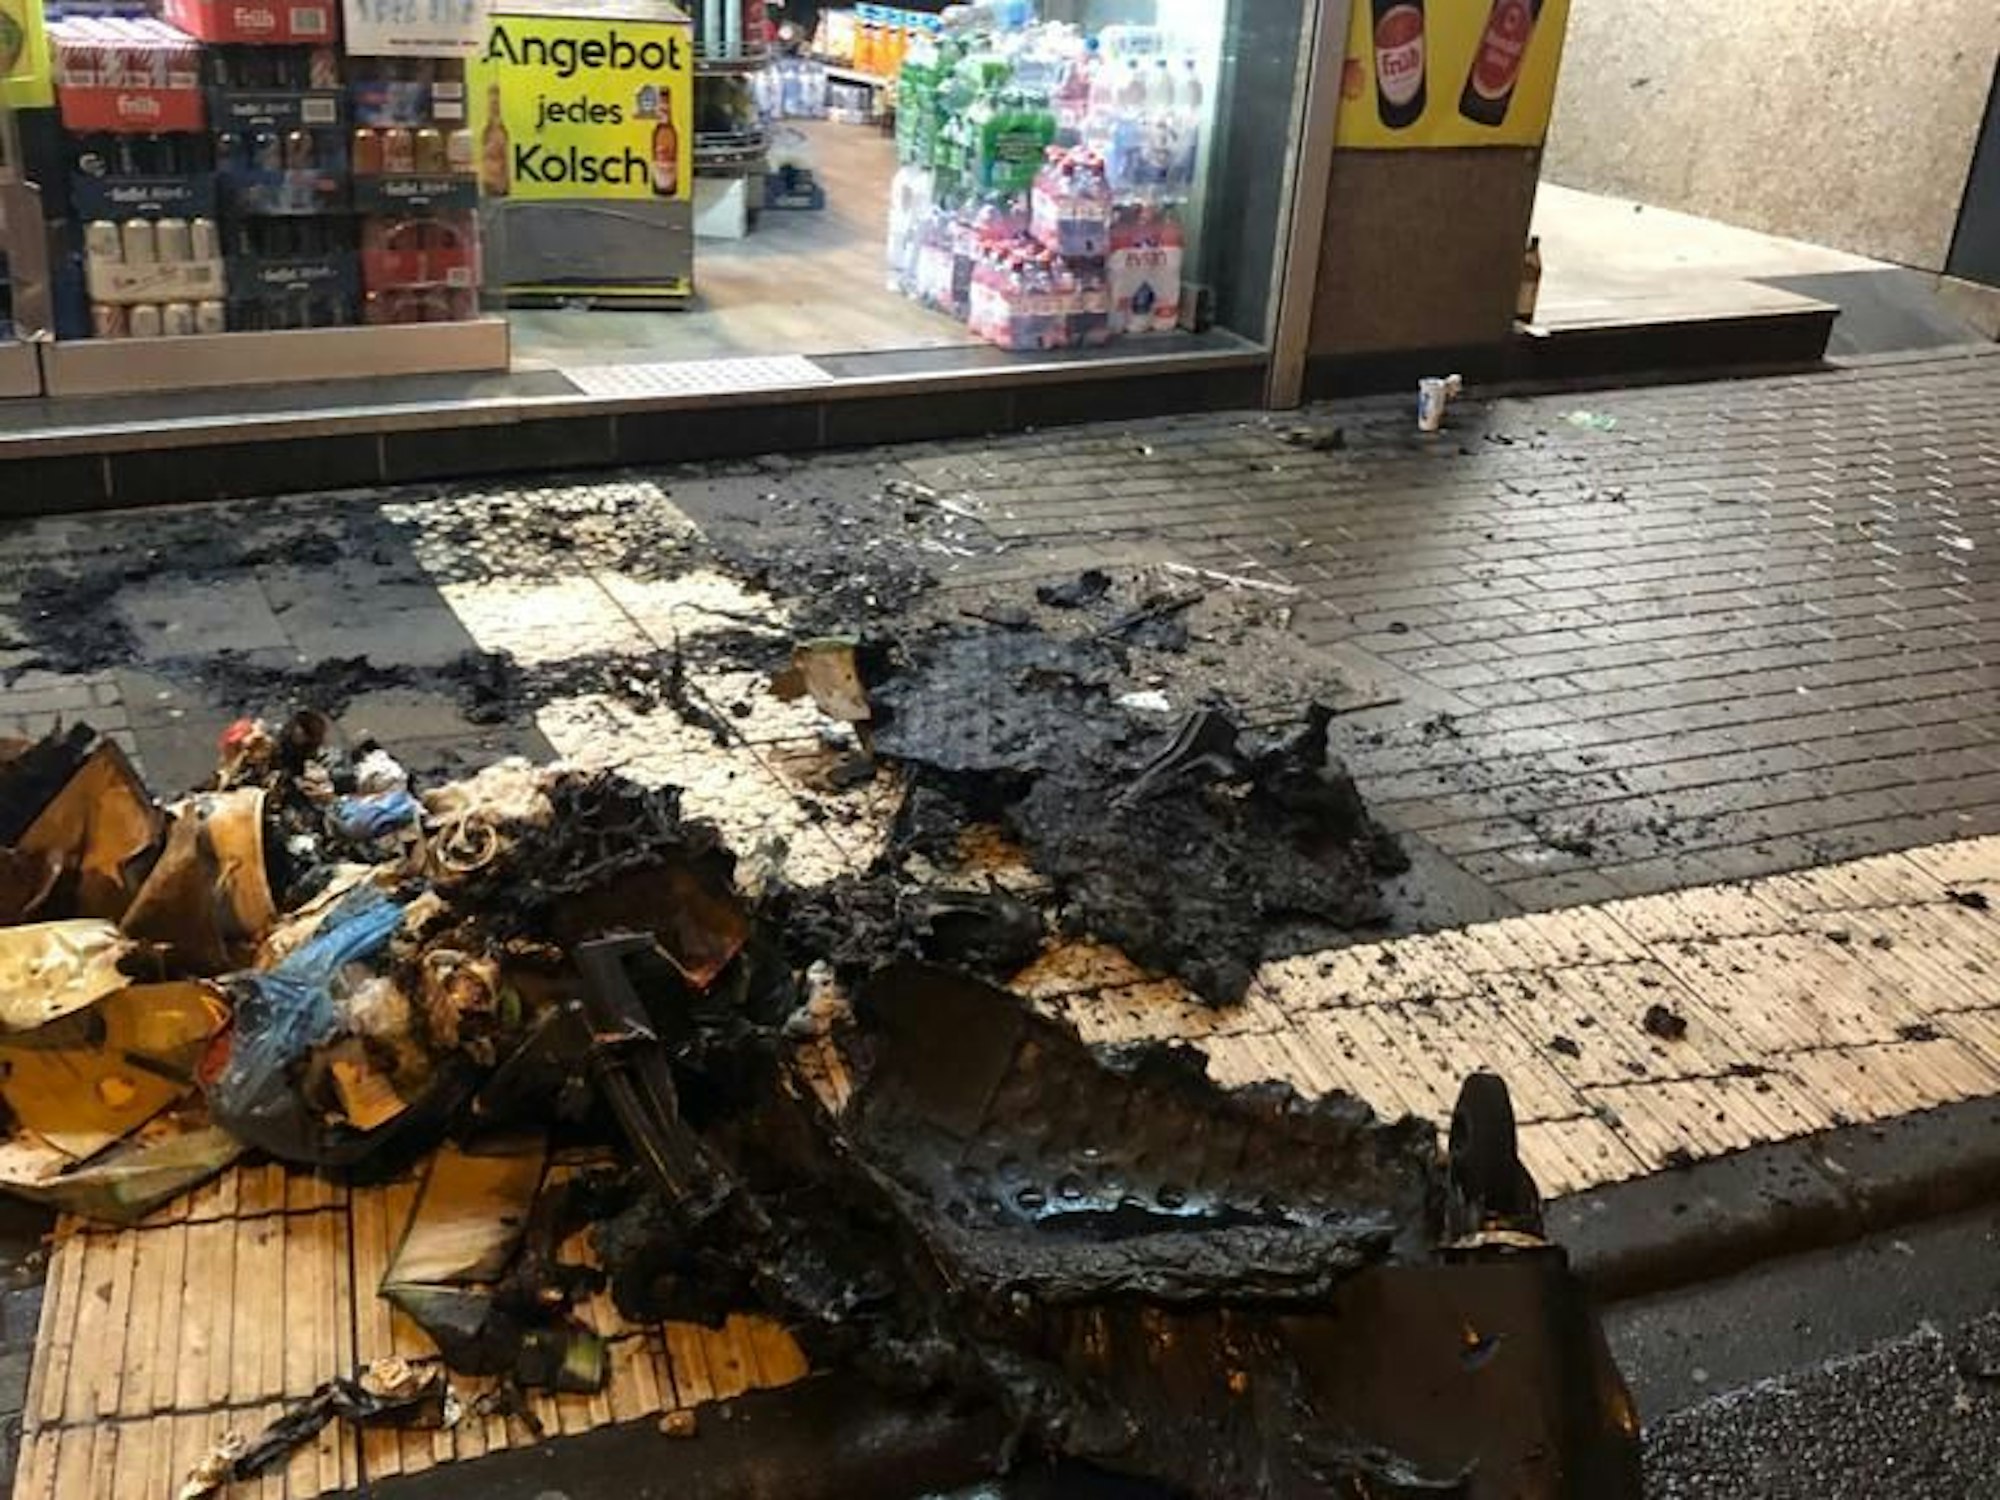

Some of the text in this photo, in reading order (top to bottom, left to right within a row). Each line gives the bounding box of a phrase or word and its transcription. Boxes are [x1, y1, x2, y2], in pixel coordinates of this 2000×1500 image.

[481, 24, 682, 78] Angebot
[535, 93, 623, 132] jedes
[515, 143, 649, 184] Kolsch
